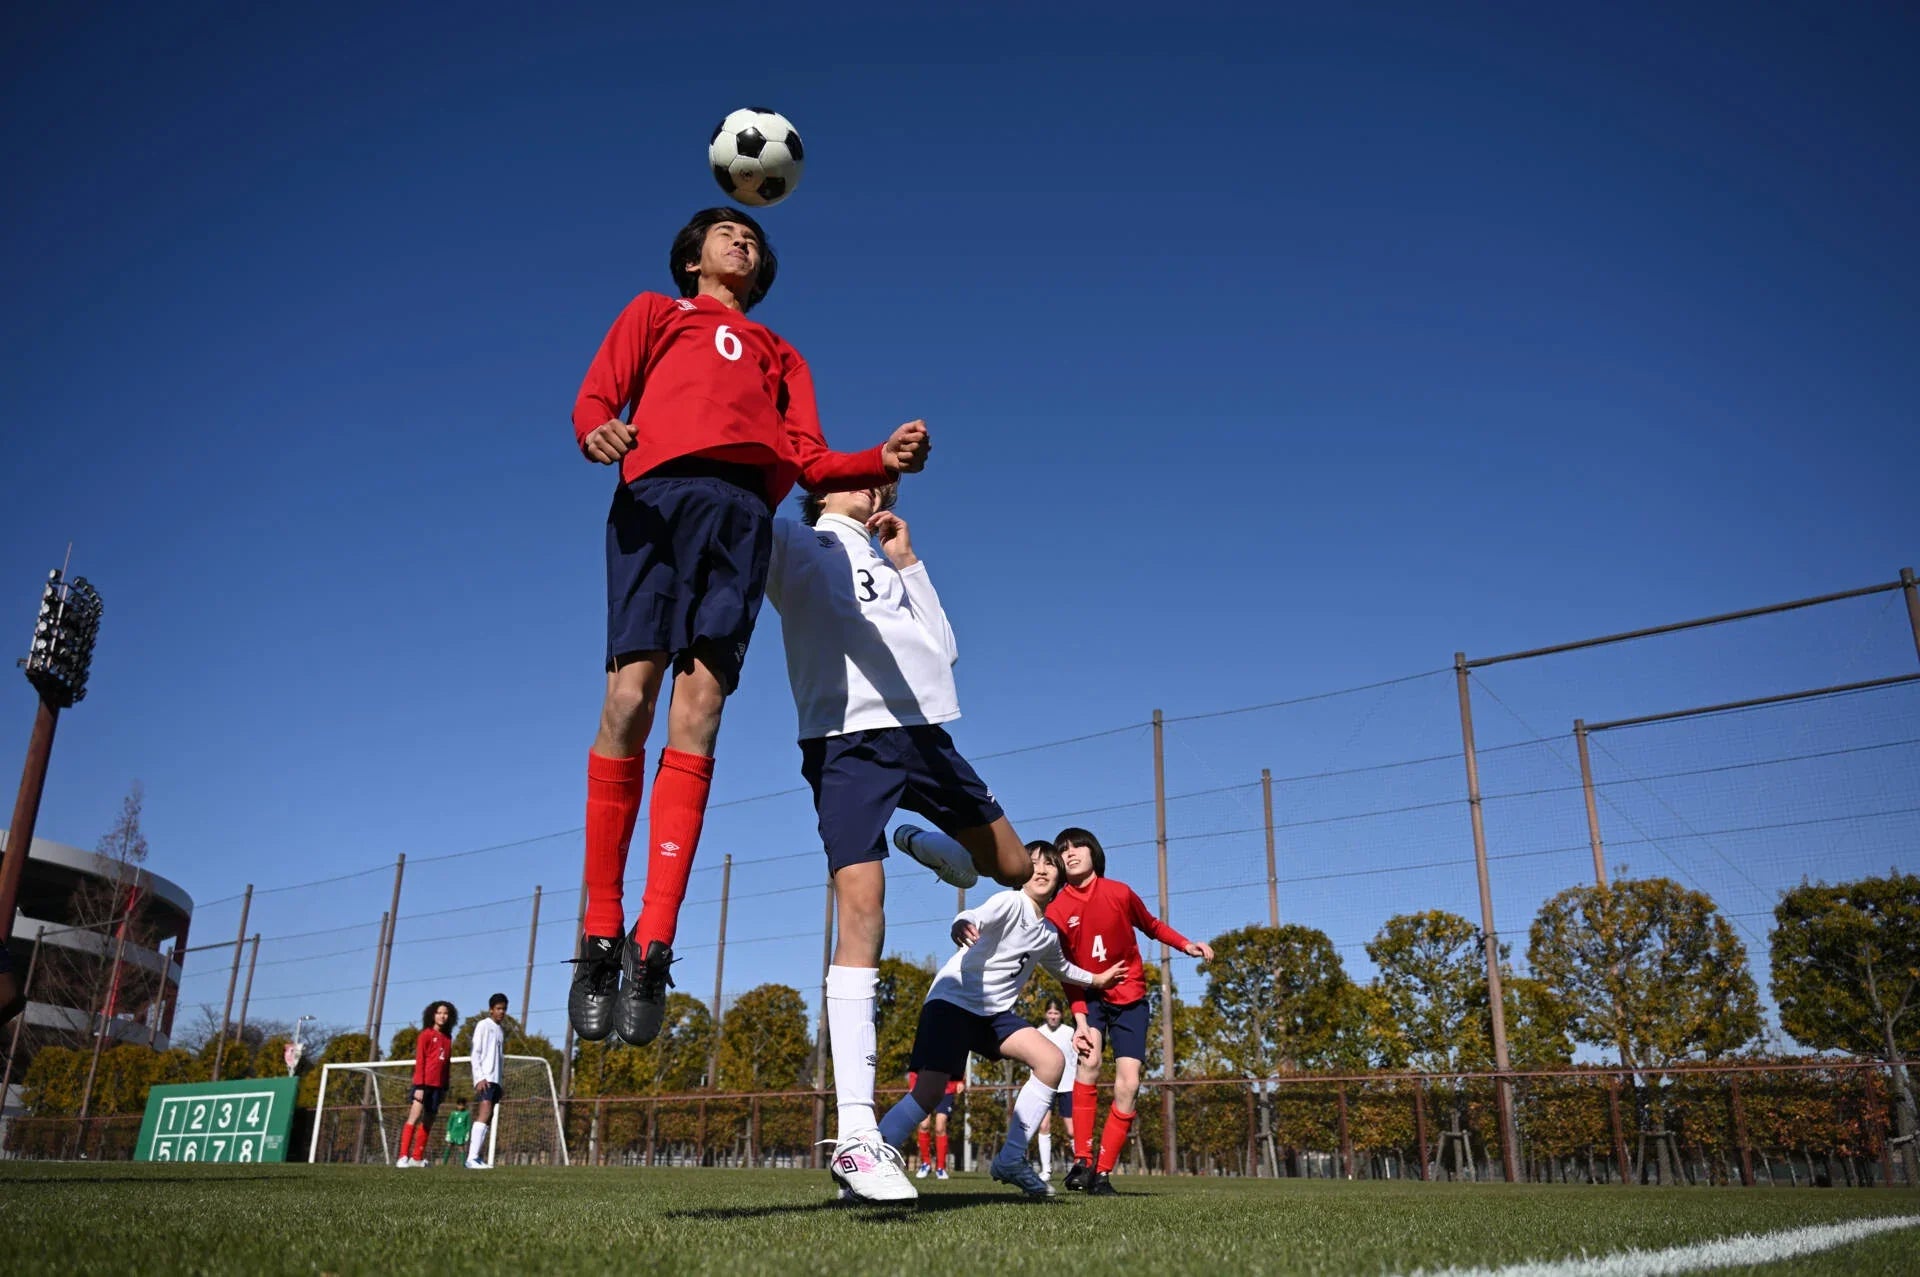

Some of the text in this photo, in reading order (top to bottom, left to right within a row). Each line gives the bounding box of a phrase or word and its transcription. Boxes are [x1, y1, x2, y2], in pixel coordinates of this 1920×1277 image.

[714, 324, 743, 361] 6
[857, 569, 879, 602] 3
[1091, 934, 1107, 962] 4
[1010, 952, 1030, 978] 5
[168, 1101, 260, 1130] 1 2 3 4
[158, 1142, 171, 1162] 5
[184, 1141, 197, 1162] 6
[212, 1140, 226, 1162] 7
[239, 1139, 253, 1162] 8
